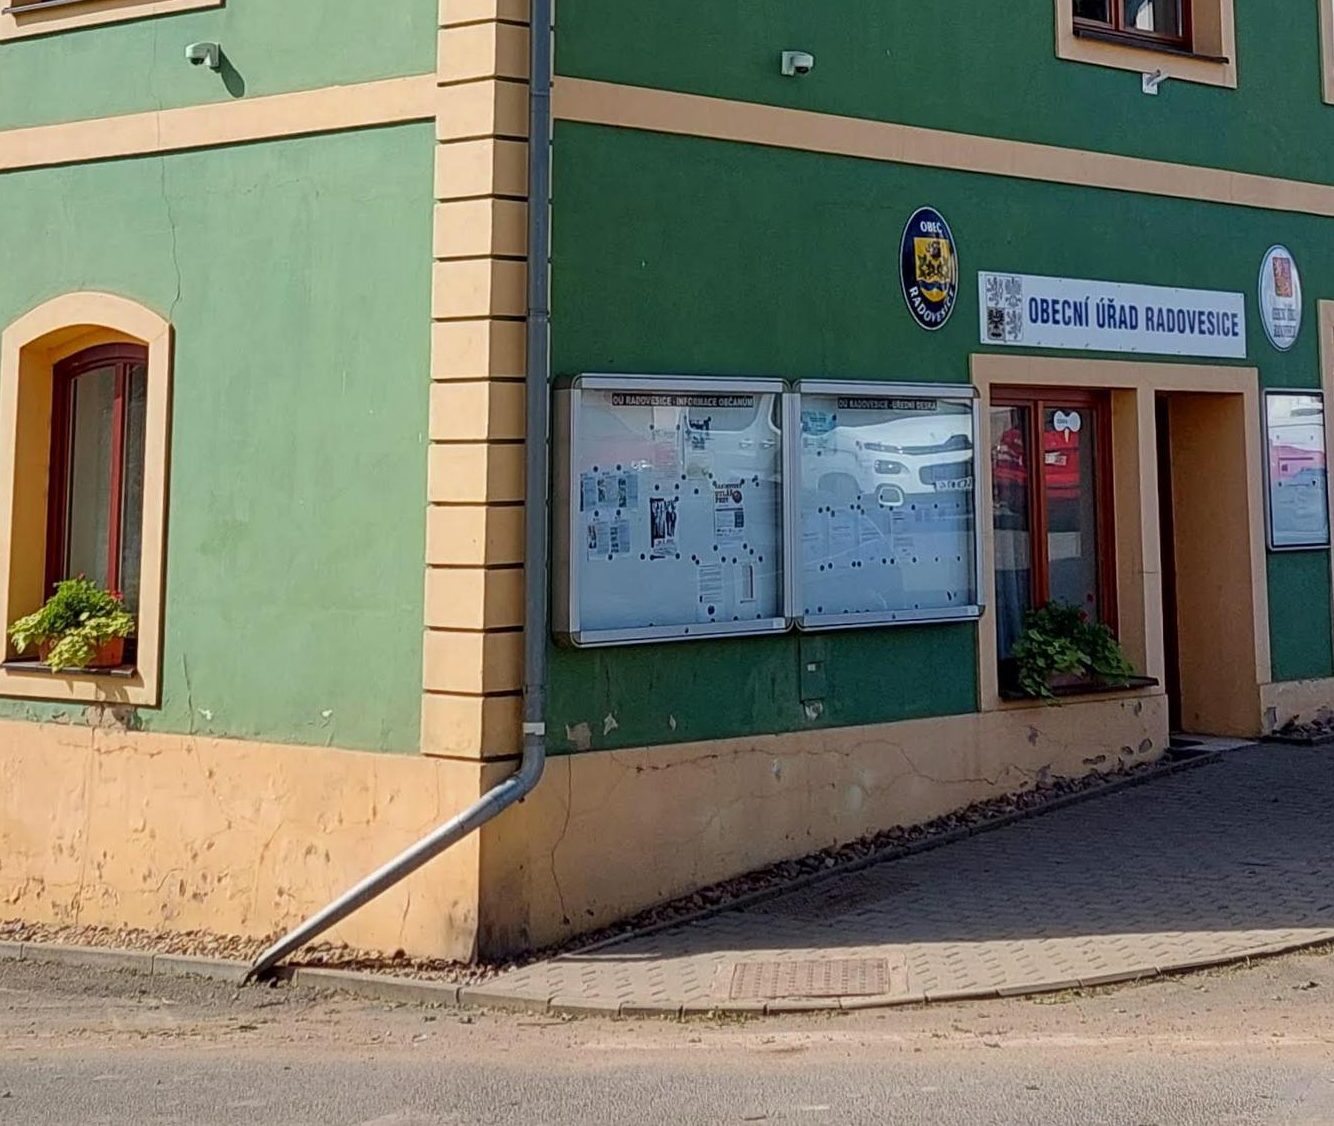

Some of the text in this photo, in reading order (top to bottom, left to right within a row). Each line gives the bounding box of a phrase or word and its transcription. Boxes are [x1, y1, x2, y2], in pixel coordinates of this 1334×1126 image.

[920, 221, 943, 233] OBEC
[1028, 295, 1089, 327] OBECNÍ
[1096, 297, 1138, 331] ÚŘAD
[1145, 306, 1239, 337] RADOVESICE
